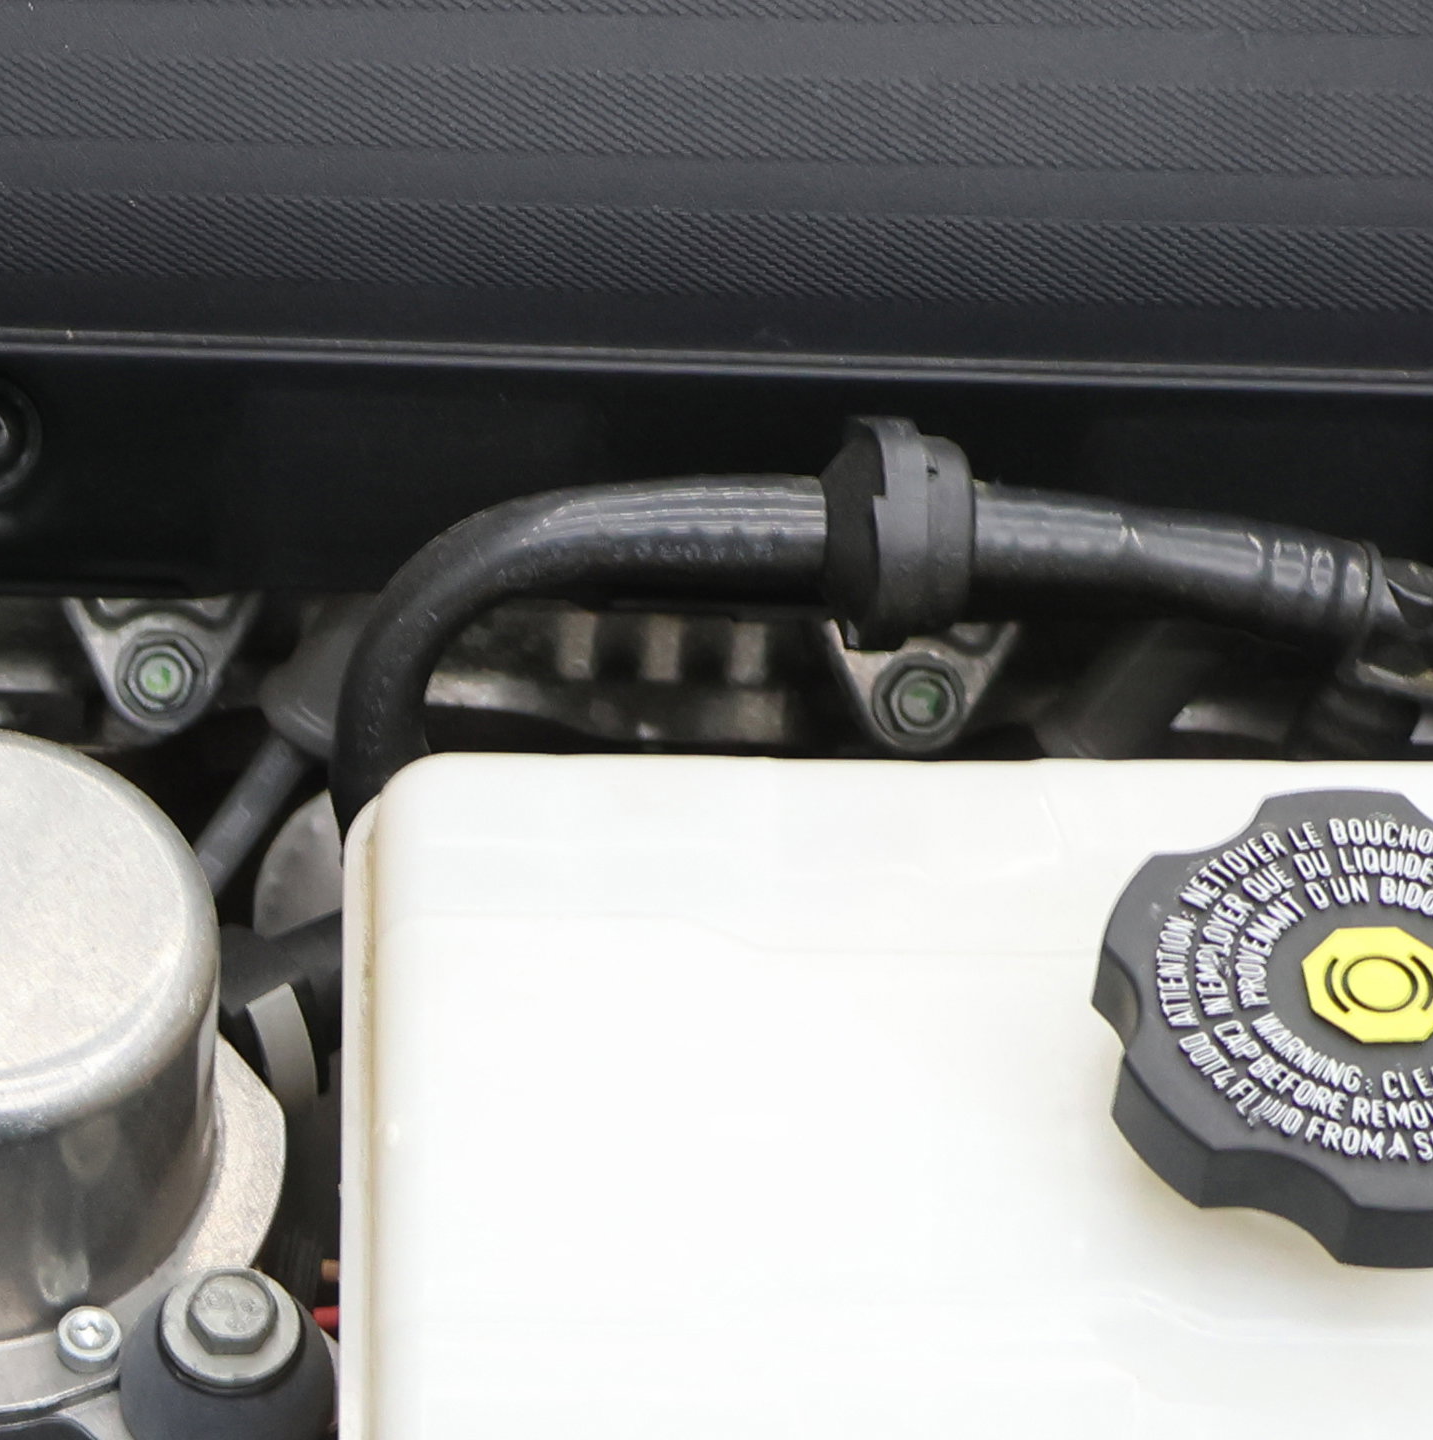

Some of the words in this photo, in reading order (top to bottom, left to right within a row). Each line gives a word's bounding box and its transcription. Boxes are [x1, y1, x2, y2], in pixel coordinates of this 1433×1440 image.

[1179, 831, 1288, 910] NETTOYER
[1288, 821, 1323, 851] LE
[1242, 862, 1295, 902] QUE
[1293, 849, 1332, 880] DU
[1234, 891, 1306, 1008] PROVENANT
[1304, 875, 1370, 910] D'UN
[1213, 1020, 1262, 1059] CAP
[1247, 1053, 1348, 1120] BEFORE
[1305, 1115, 1385, 1159] FROM
[1386, 1132, 1410, 1159] A
